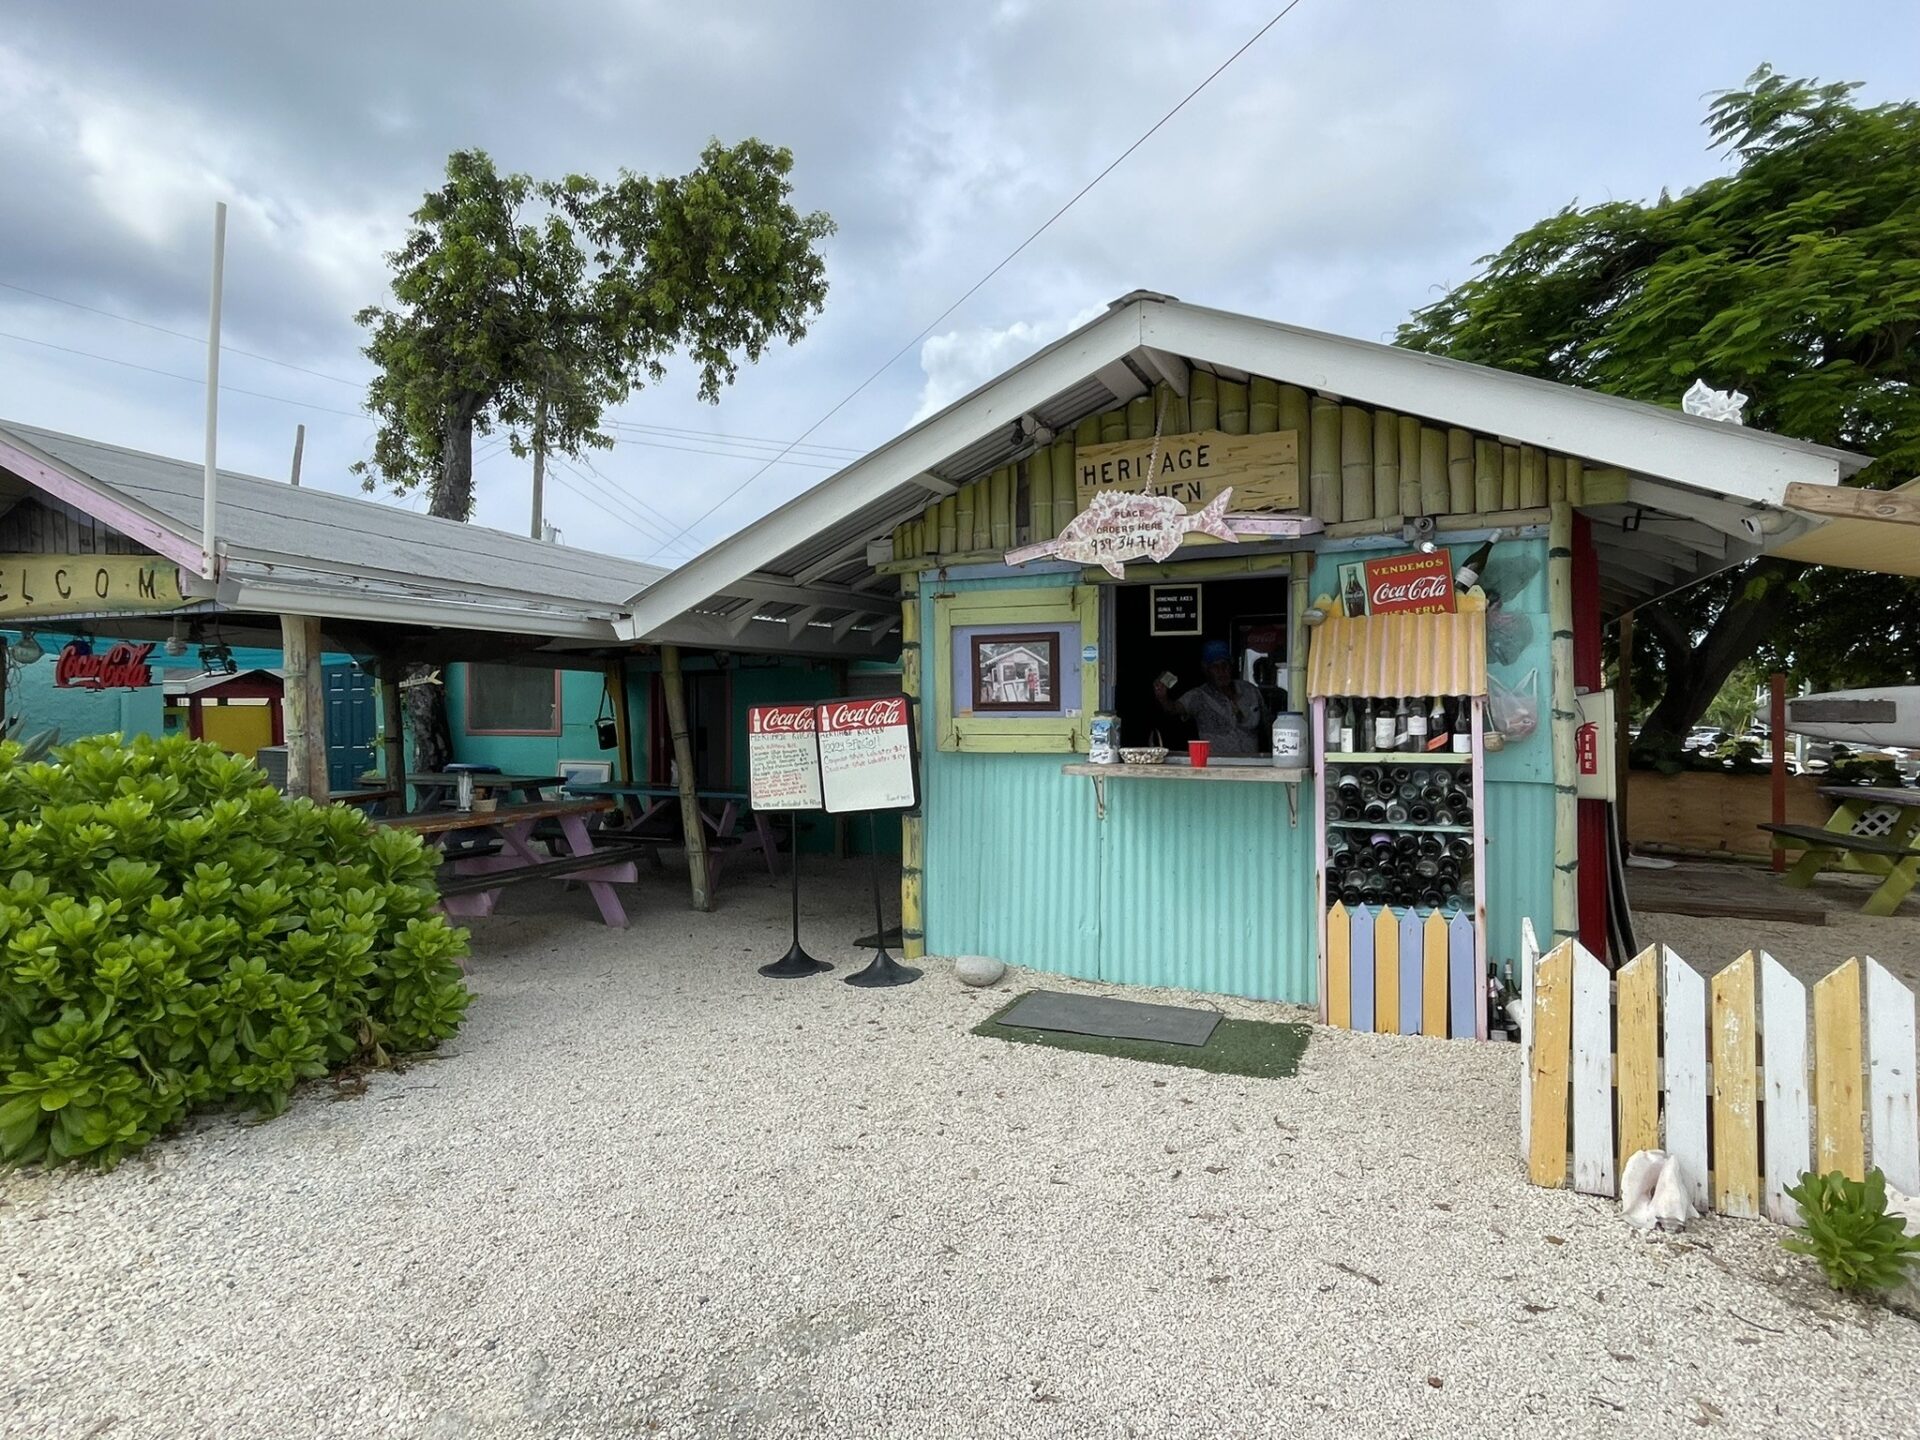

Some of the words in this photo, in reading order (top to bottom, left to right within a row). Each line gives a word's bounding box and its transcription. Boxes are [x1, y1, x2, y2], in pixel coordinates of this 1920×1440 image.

[1114, 510, 1145, 519] PLACE
[1096, 524, 1135, 534] ORDERS
[1138, 522, 1163, 531] HERE
[1091, 538, 1112, 555] 939
[1118, 535, 1157, 550] 3474
[1372, 558, 1444, 575] VENDEMOS
[1373, 574, 1448, 605] Coca-Cola
[832, 699, 903, 729] Coca-Cola
[1584, 734, 1593, 769] FIRE
